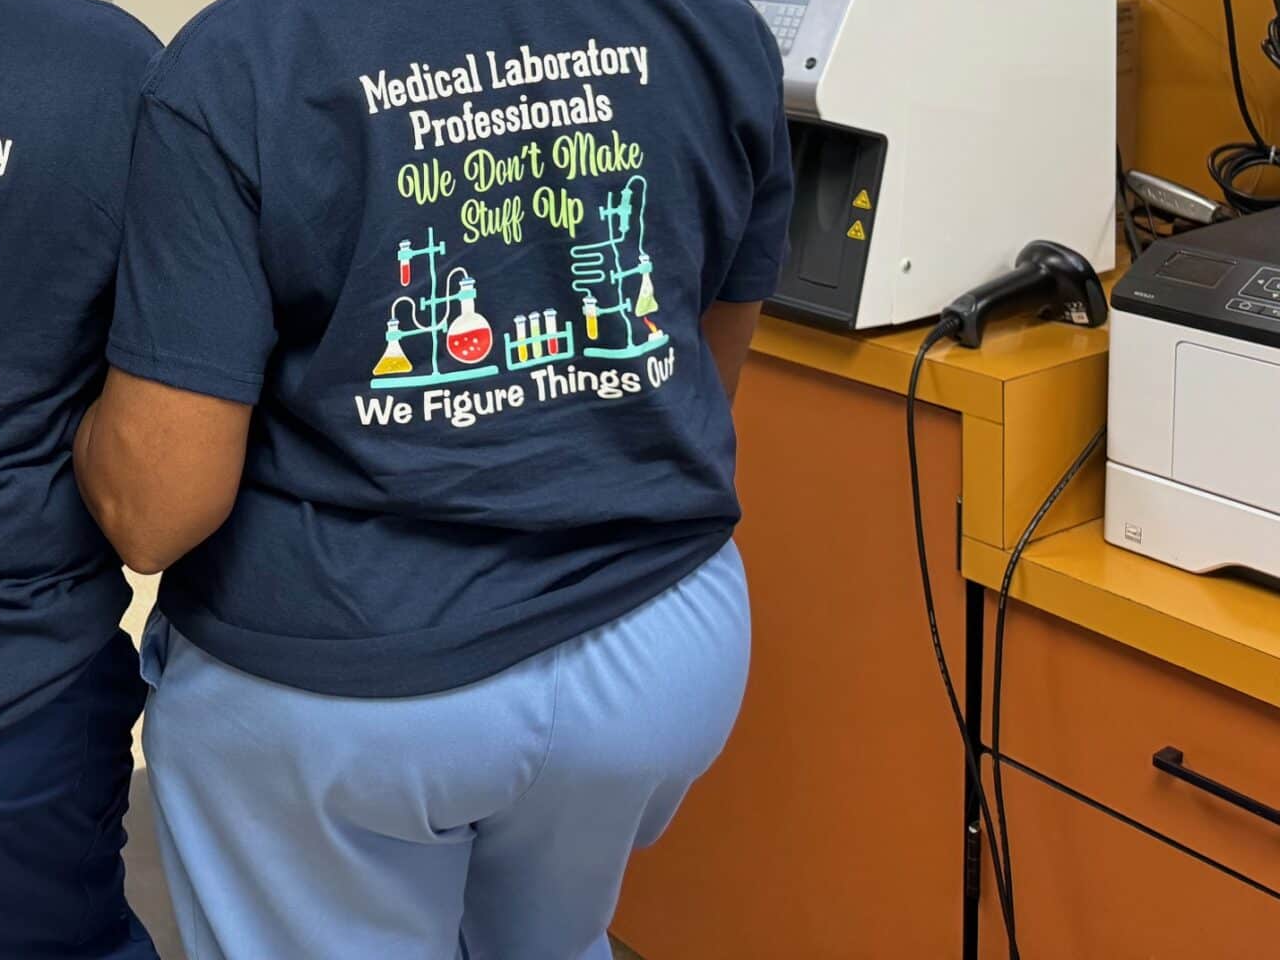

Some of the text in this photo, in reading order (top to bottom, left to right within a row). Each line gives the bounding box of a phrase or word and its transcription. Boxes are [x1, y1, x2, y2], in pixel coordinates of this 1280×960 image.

[359, 38, 649, 115] Medical Laboratory
[409, 84, 613, 150] Professionals
[397, 130, 643, 205] We Don't Make
[461, 186, 584, 245] Stuff Up
[354, 346, 675, 428] We Figure Things Out
